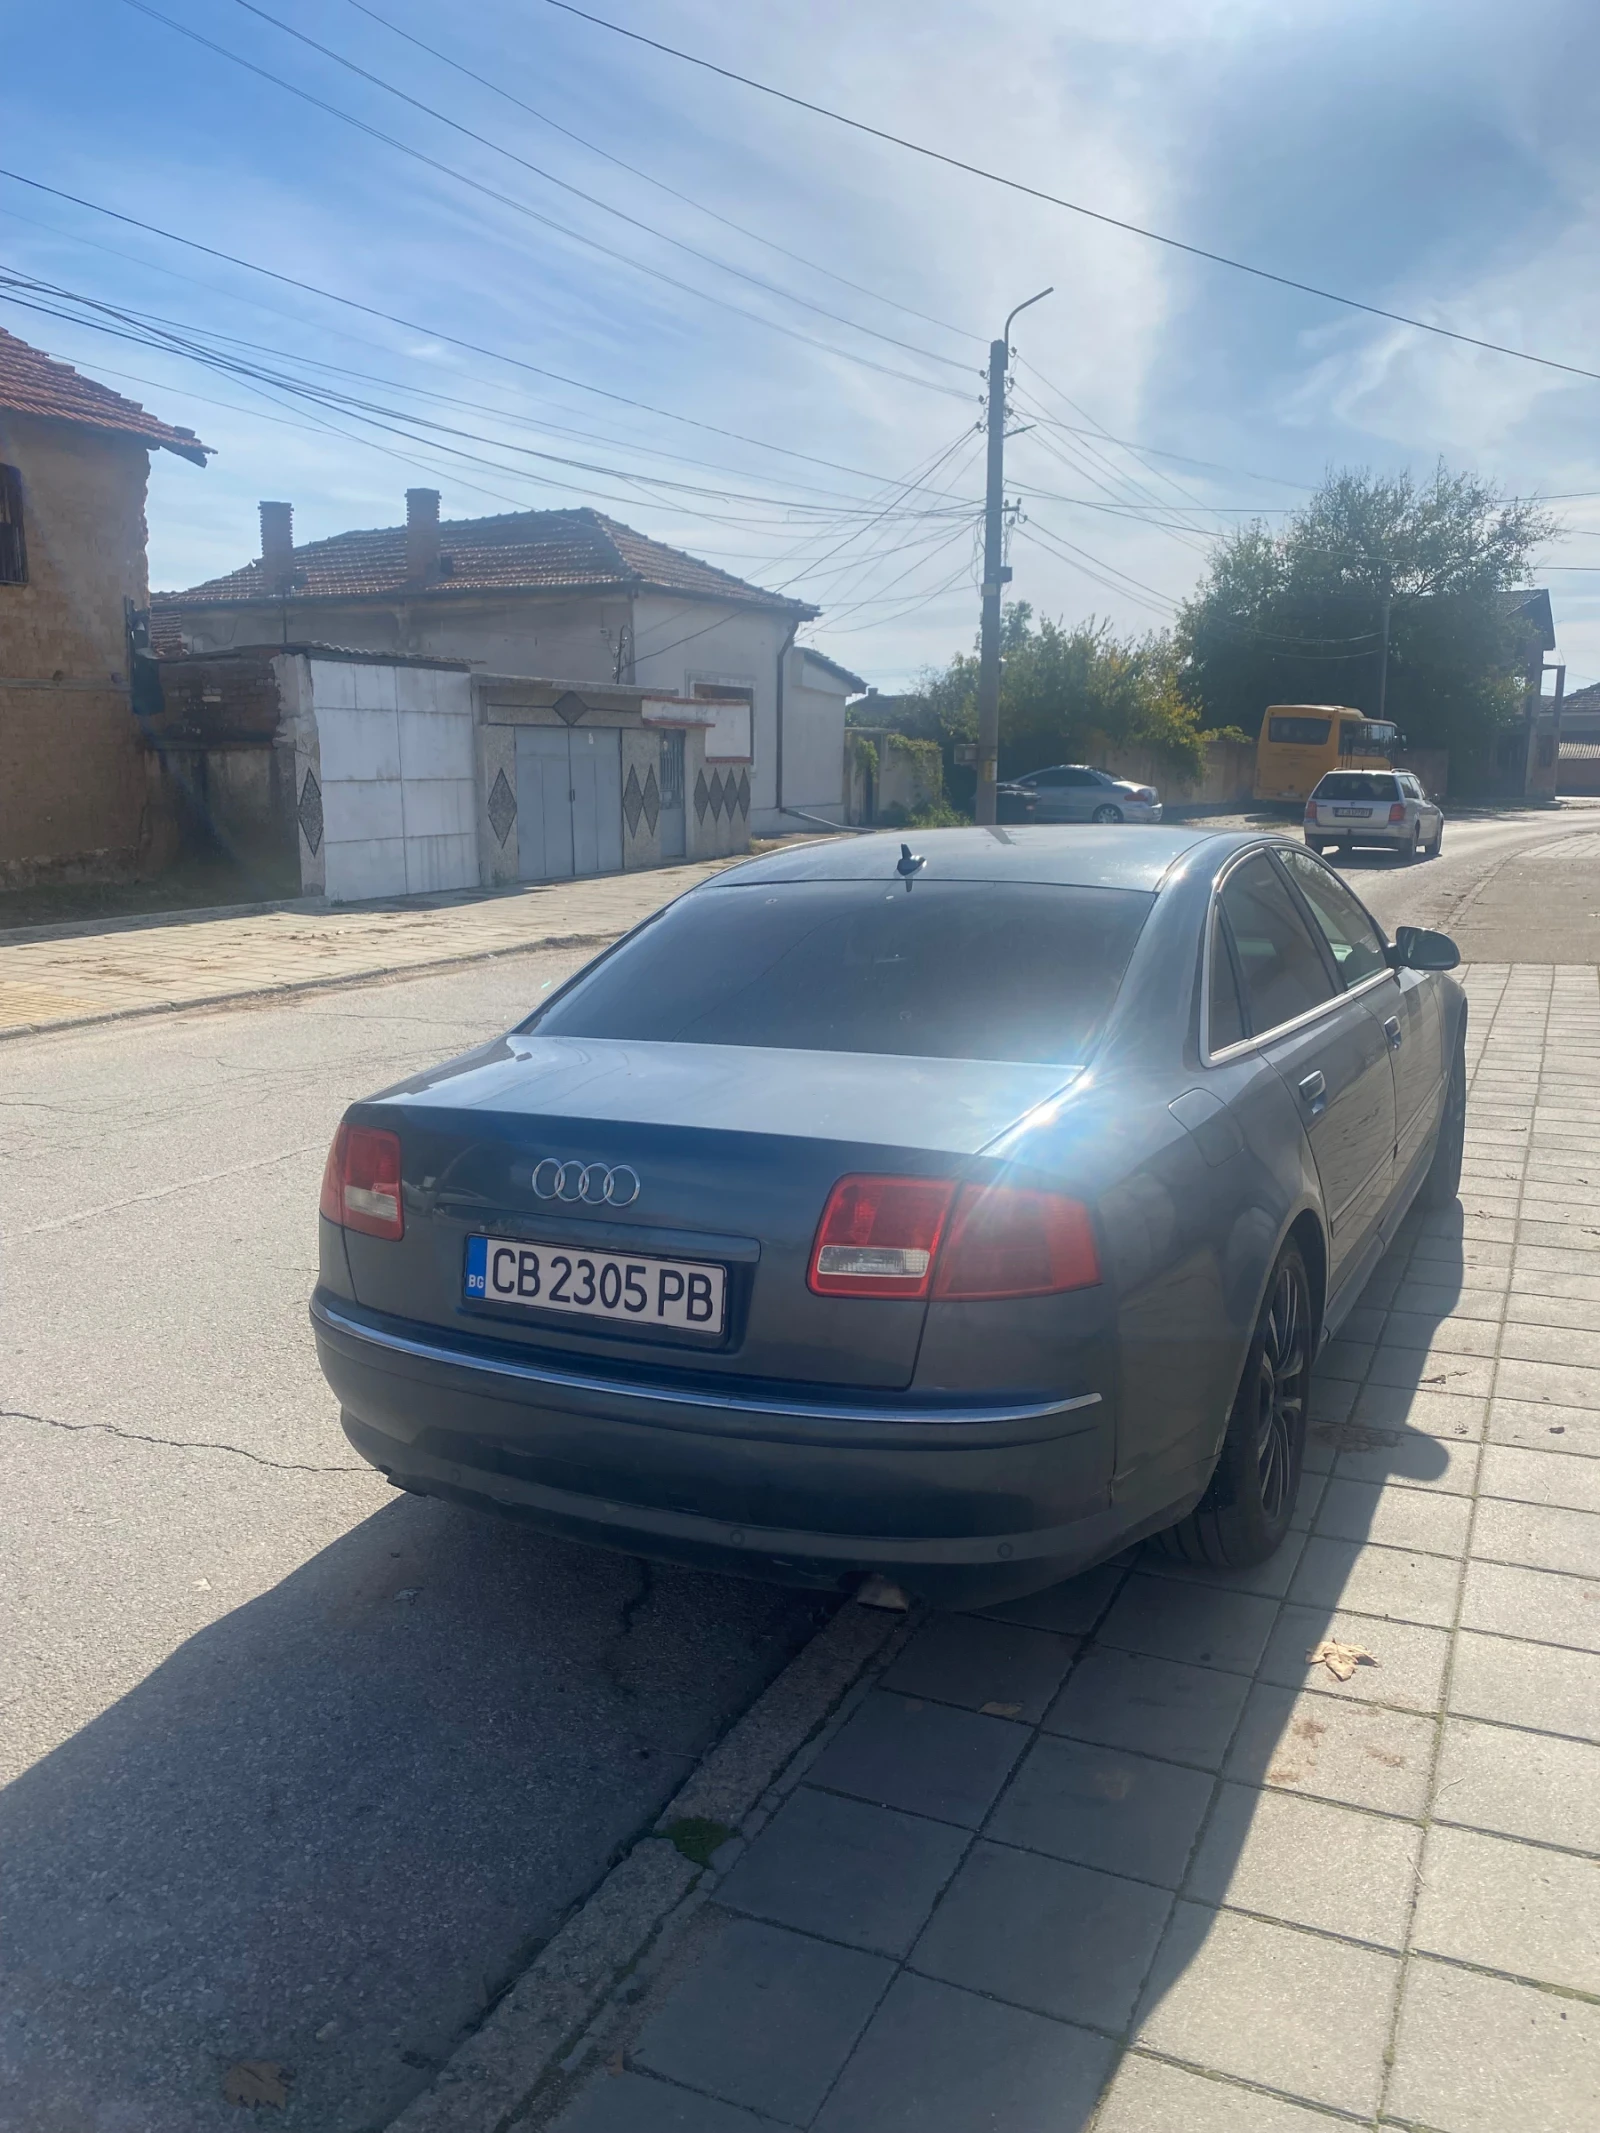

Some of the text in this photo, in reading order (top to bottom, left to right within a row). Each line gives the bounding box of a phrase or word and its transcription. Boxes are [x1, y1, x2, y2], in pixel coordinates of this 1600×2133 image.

[468, 1274, 485, 1289] BG
[492, 1248, 714, 1322] CB 2305 PB
